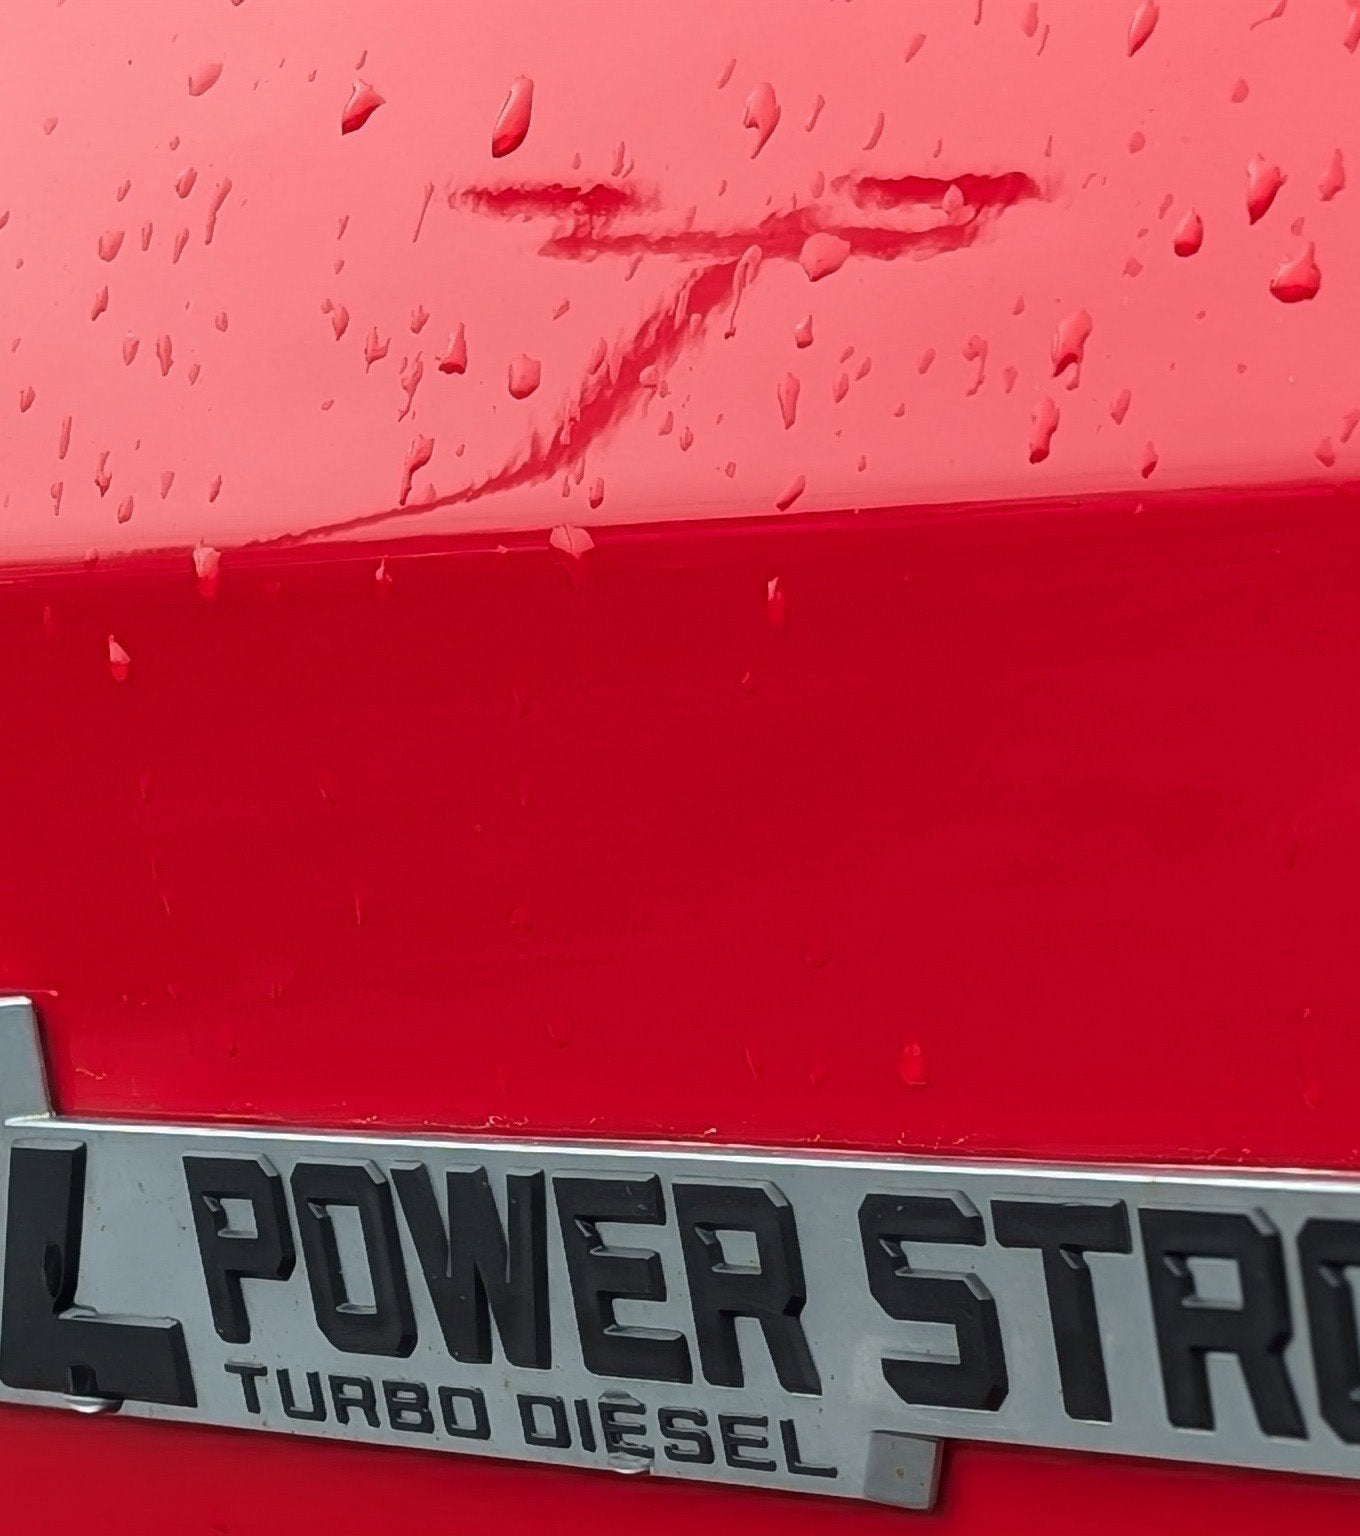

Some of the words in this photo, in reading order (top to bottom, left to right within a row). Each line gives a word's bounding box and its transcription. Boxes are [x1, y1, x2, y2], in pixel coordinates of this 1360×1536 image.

[182, 1151, 823, 1395] POWER
[224, 1363, 492, 1440] TURBO
[516, 1393, 838, 1478] DIESEL
